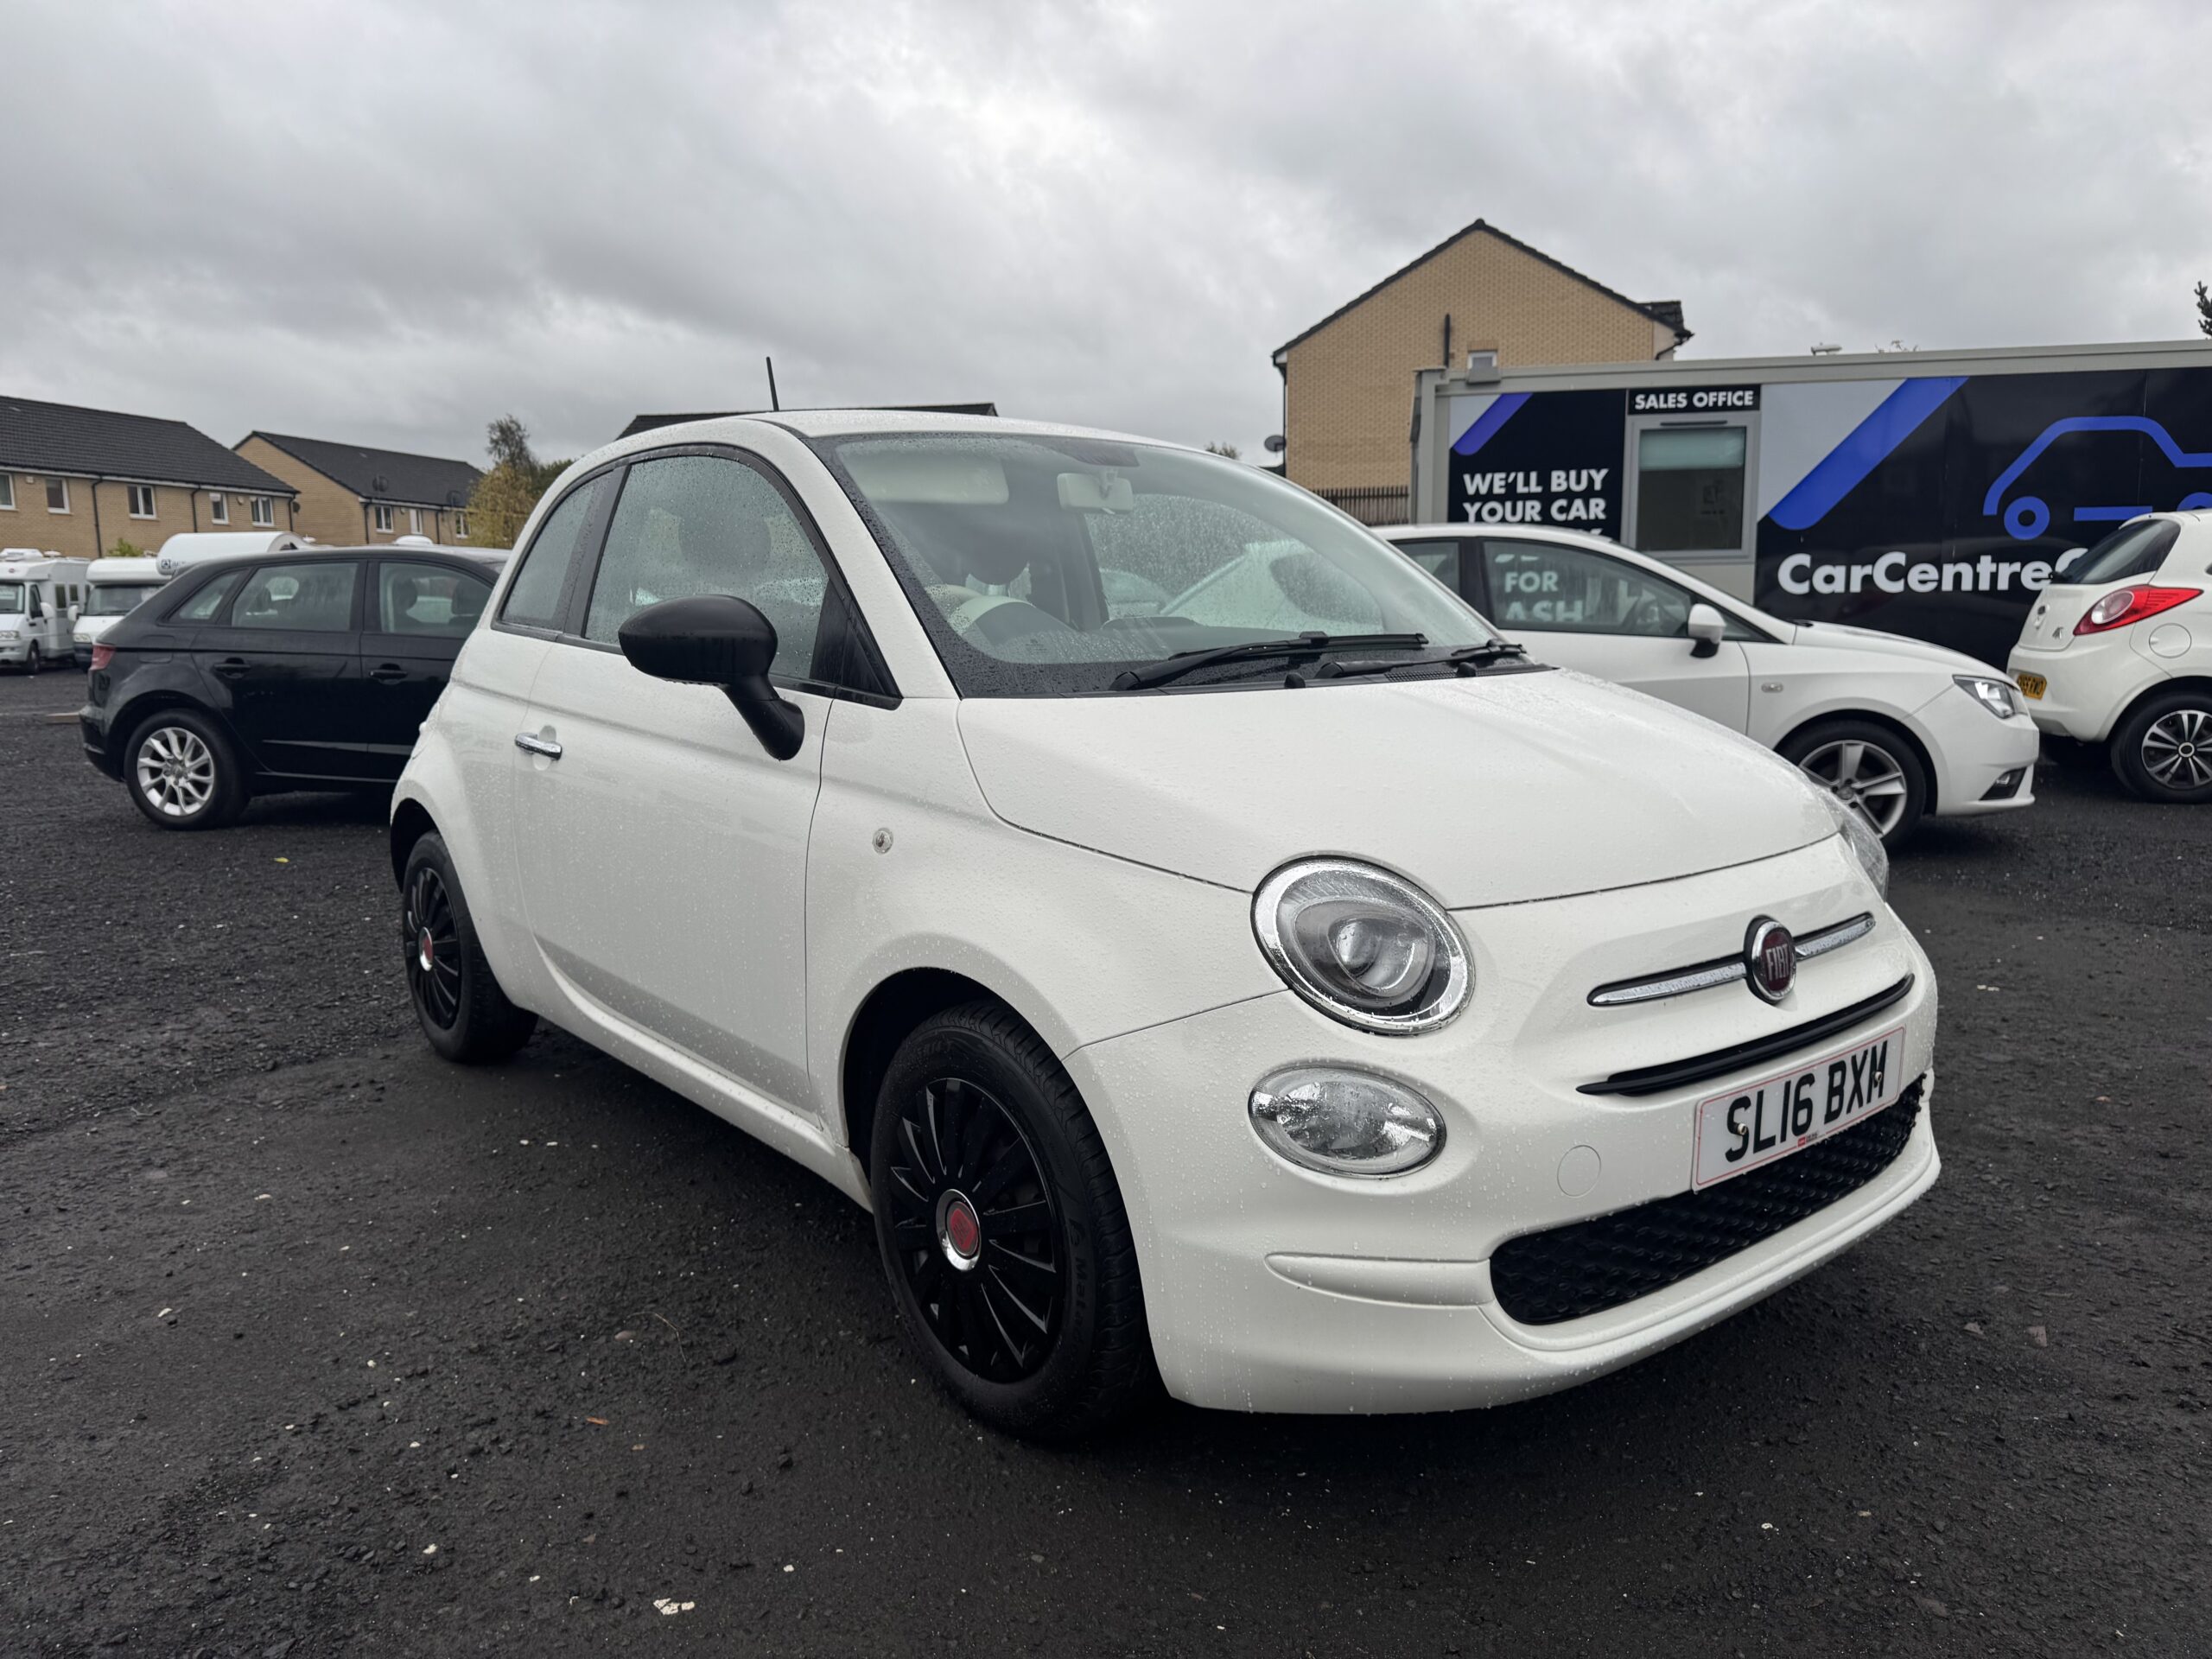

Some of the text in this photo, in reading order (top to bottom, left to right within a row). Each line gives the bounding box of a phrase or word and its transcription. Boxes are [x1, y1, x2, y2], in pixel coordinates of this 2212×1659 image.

[1635, 391, 1754, 410] SALES OFFICE
[1463, 468, 1609, 495] WE'LL BUY
[1462, 498, 1606, 524] YOUR CAR
[1504, 570, 1559, 594] FOR
[1505, 600, 1583, 623] ASH
[1765, 943, 1789, 982] FIAT
[1725, 1040, 1888, 1163] SL16 BXM
